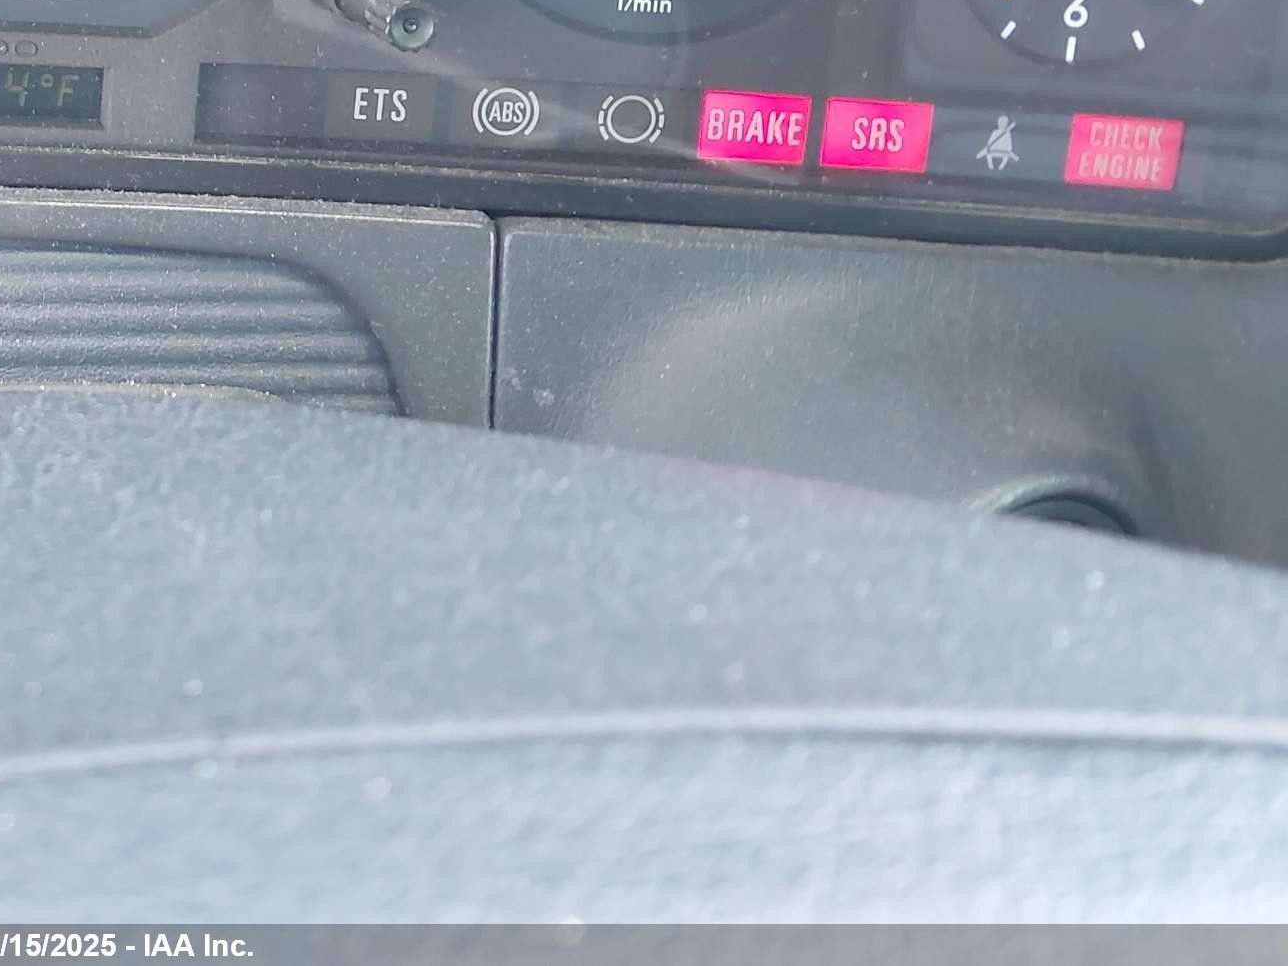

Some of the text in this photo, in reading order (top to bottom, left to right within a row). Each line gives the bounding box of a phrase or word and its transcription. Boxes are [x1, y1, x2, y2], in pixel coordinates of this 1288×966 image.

[353, 87, 408, 122] ETS
[488, 100, 524, 124] ABS
[707, 108, 804, 146] BRAKE
[851, 117, 905, 152] SRS
[1089, 120, 1162, 150] CHECK
[1079, 152, 1163, 182] ENGINE
